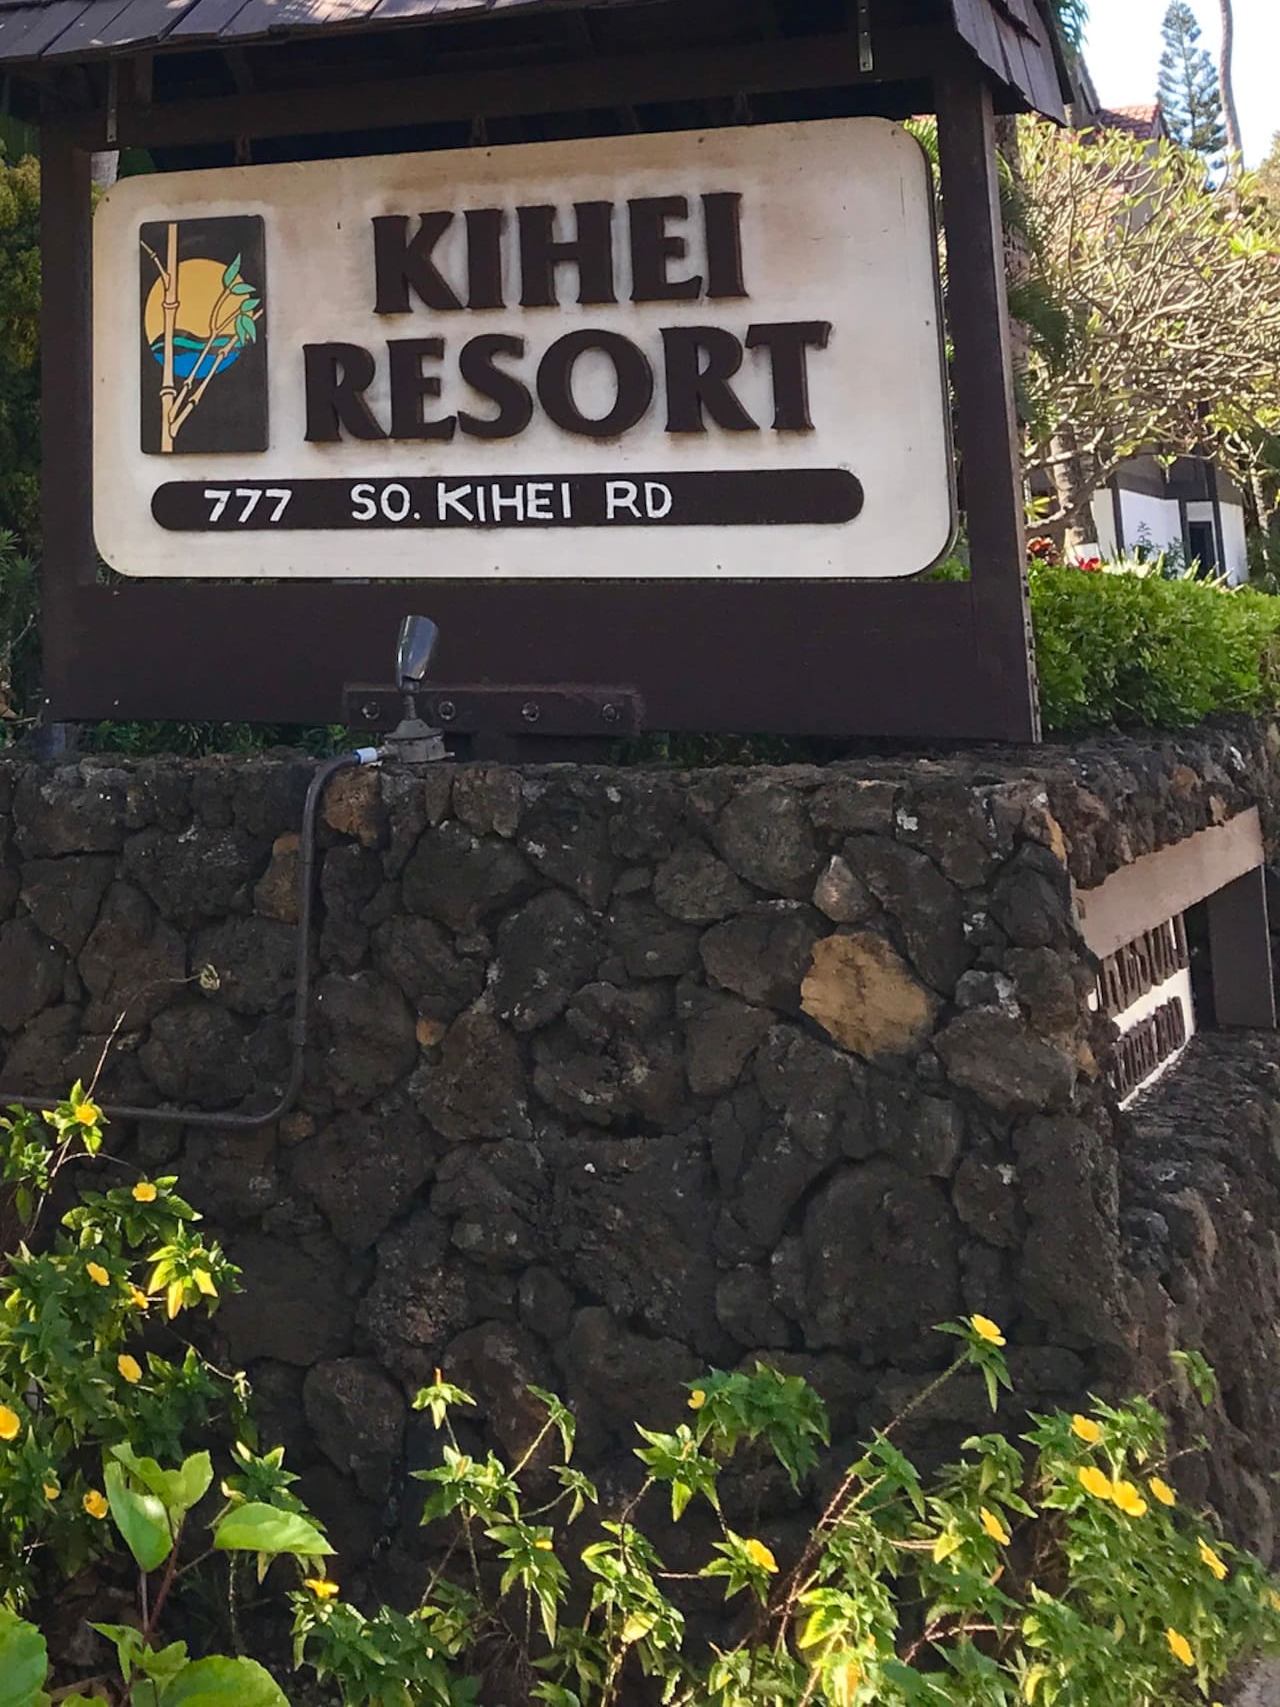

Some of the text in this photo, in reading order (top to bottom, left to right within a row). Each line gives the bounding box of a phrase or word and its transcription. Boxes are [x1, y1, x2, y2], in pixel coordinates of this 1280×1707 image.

[372, 192, 749, 314] KIHEI
[303, 320, 833, 442] RESORT
[204, 481, 673, 522] 777 SO. KIHEI RD
